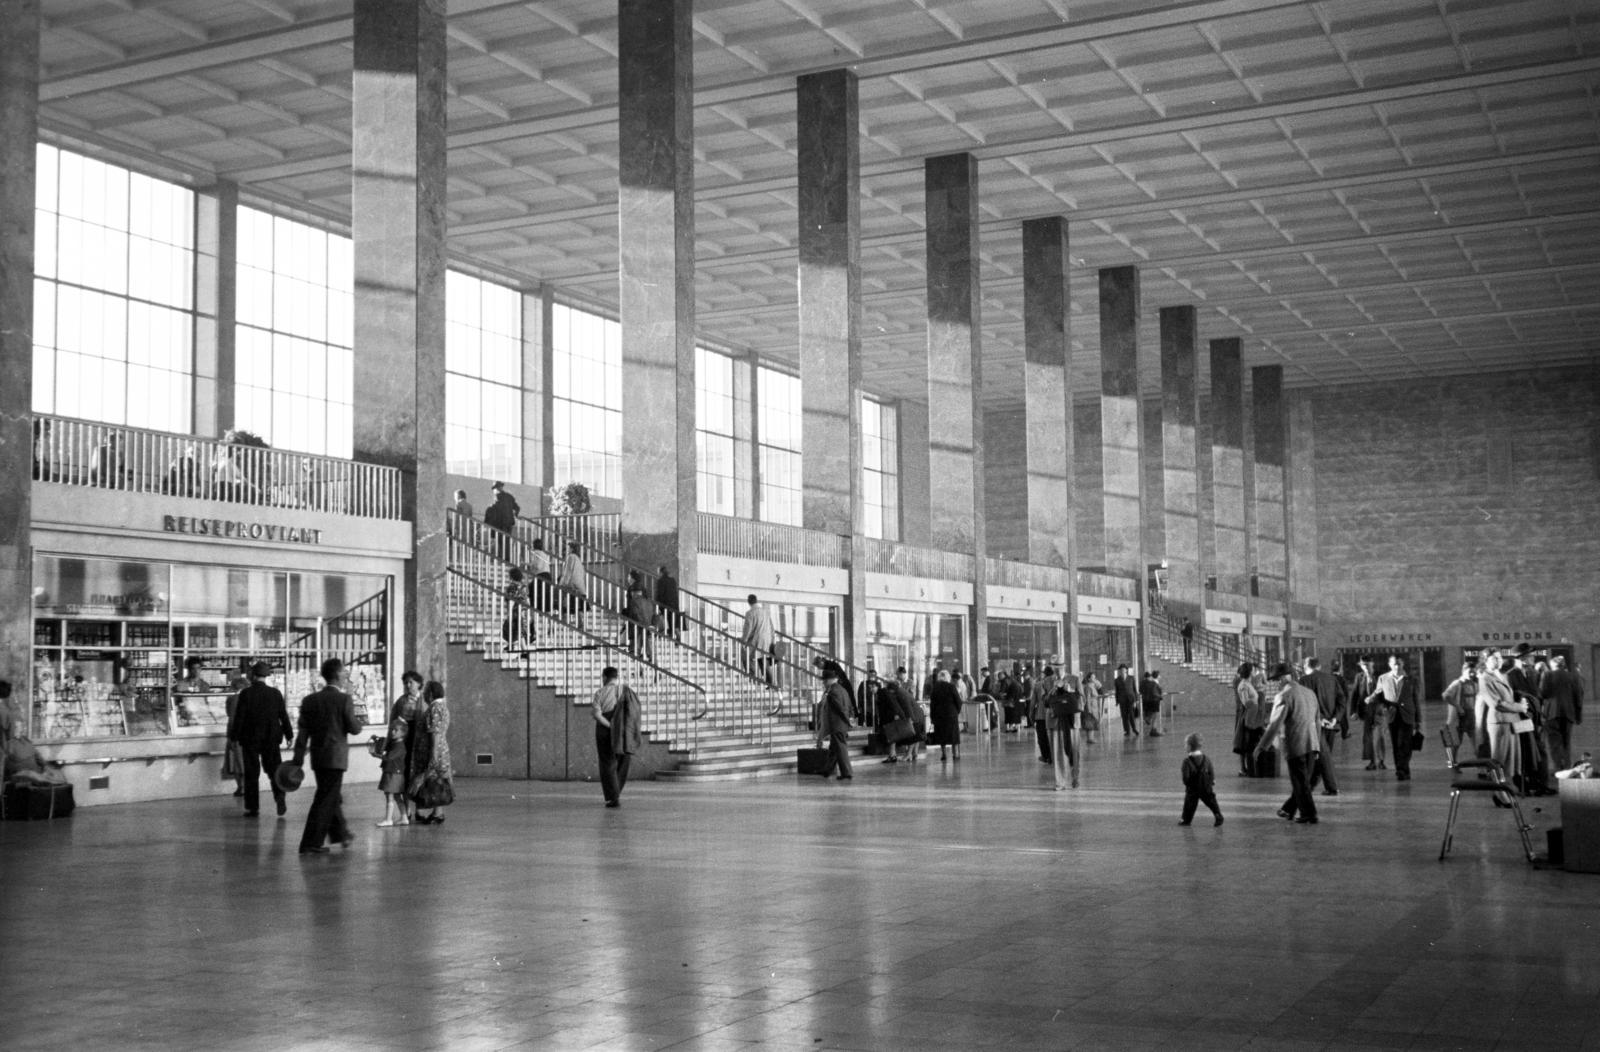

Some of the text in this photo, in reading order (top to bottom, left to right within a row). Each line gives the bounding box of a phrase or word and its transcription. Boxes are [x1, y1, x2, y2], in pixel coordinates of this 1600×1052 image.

[164, 514, 322, 544] REISEPROVIANT
[1350, 633, 1431, 642] LEDERWAREN
[1482, 631, 1552, 641] BONBONS
